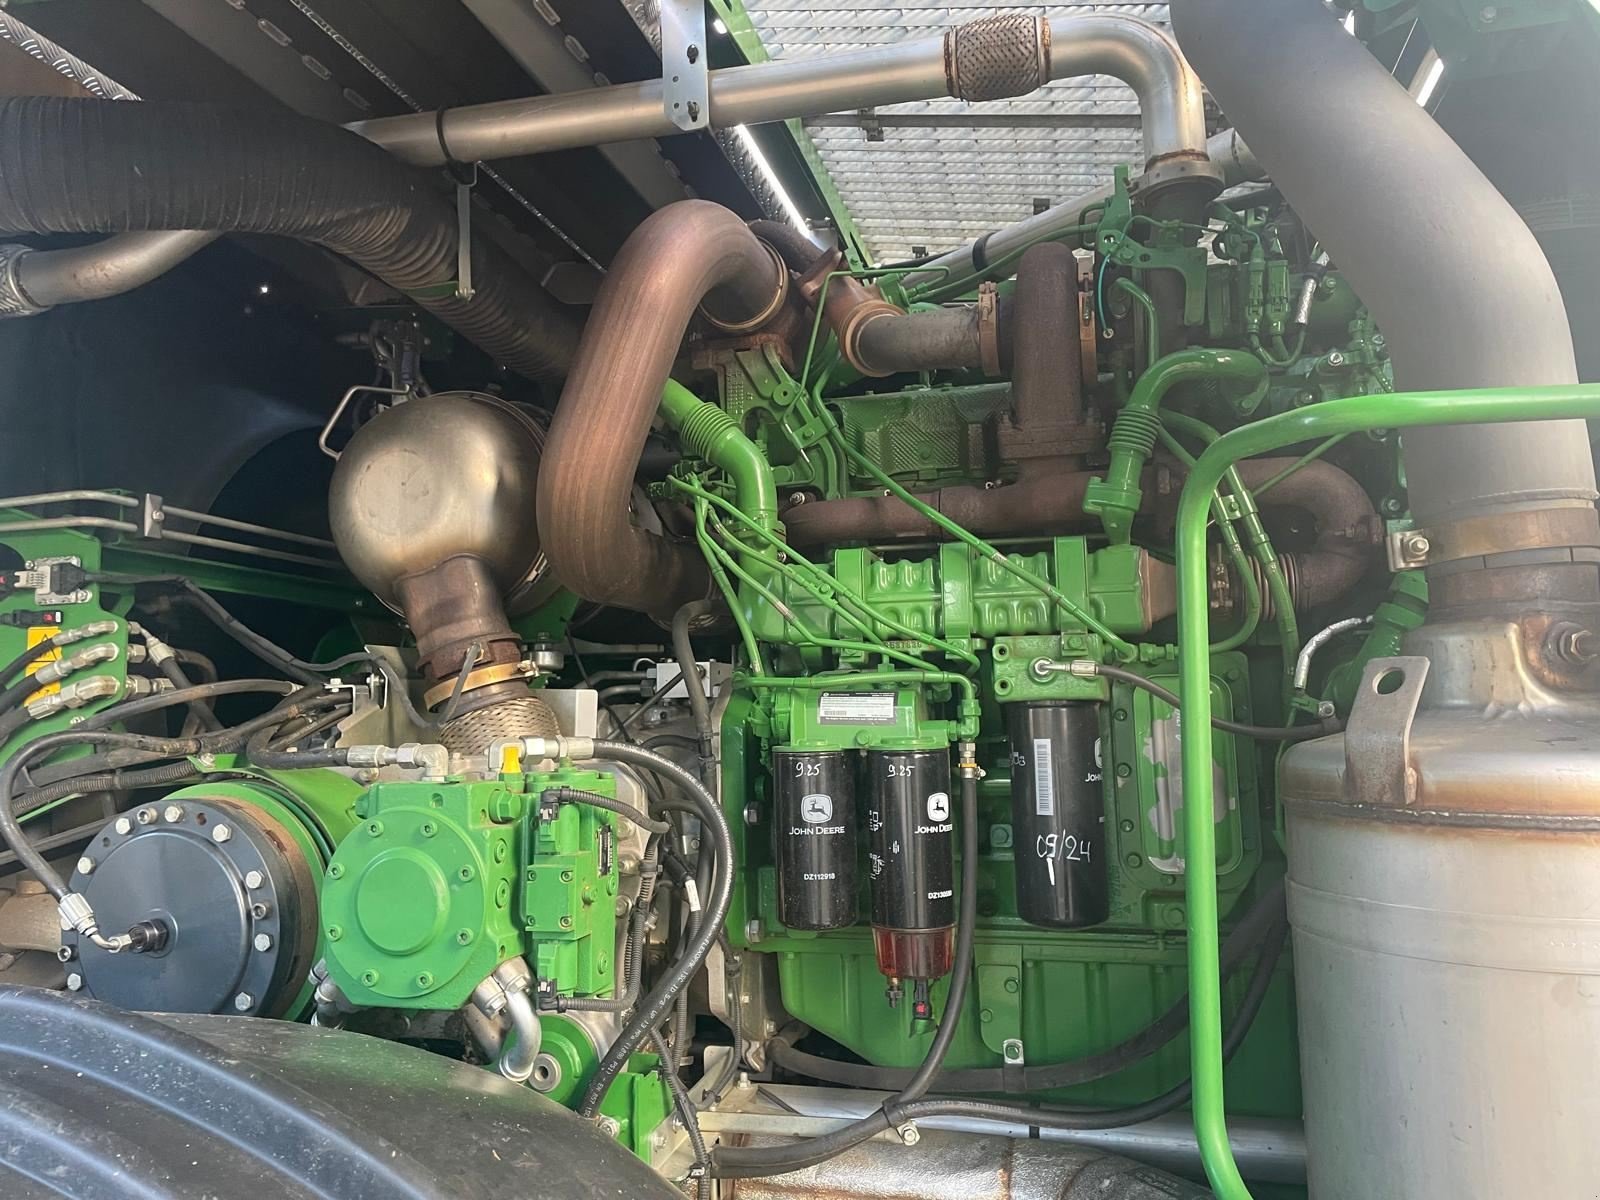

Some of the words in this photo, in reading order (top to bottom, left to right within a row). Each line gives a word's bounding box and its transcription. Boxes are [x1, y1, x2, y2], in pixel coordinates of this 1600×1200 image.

[789, 826, 814, 836] JOHN
[815, 826, 846, 835] DEERE
[914, 825, 939, 834] JOHN
[642, 1019, 650, 1028] 13
